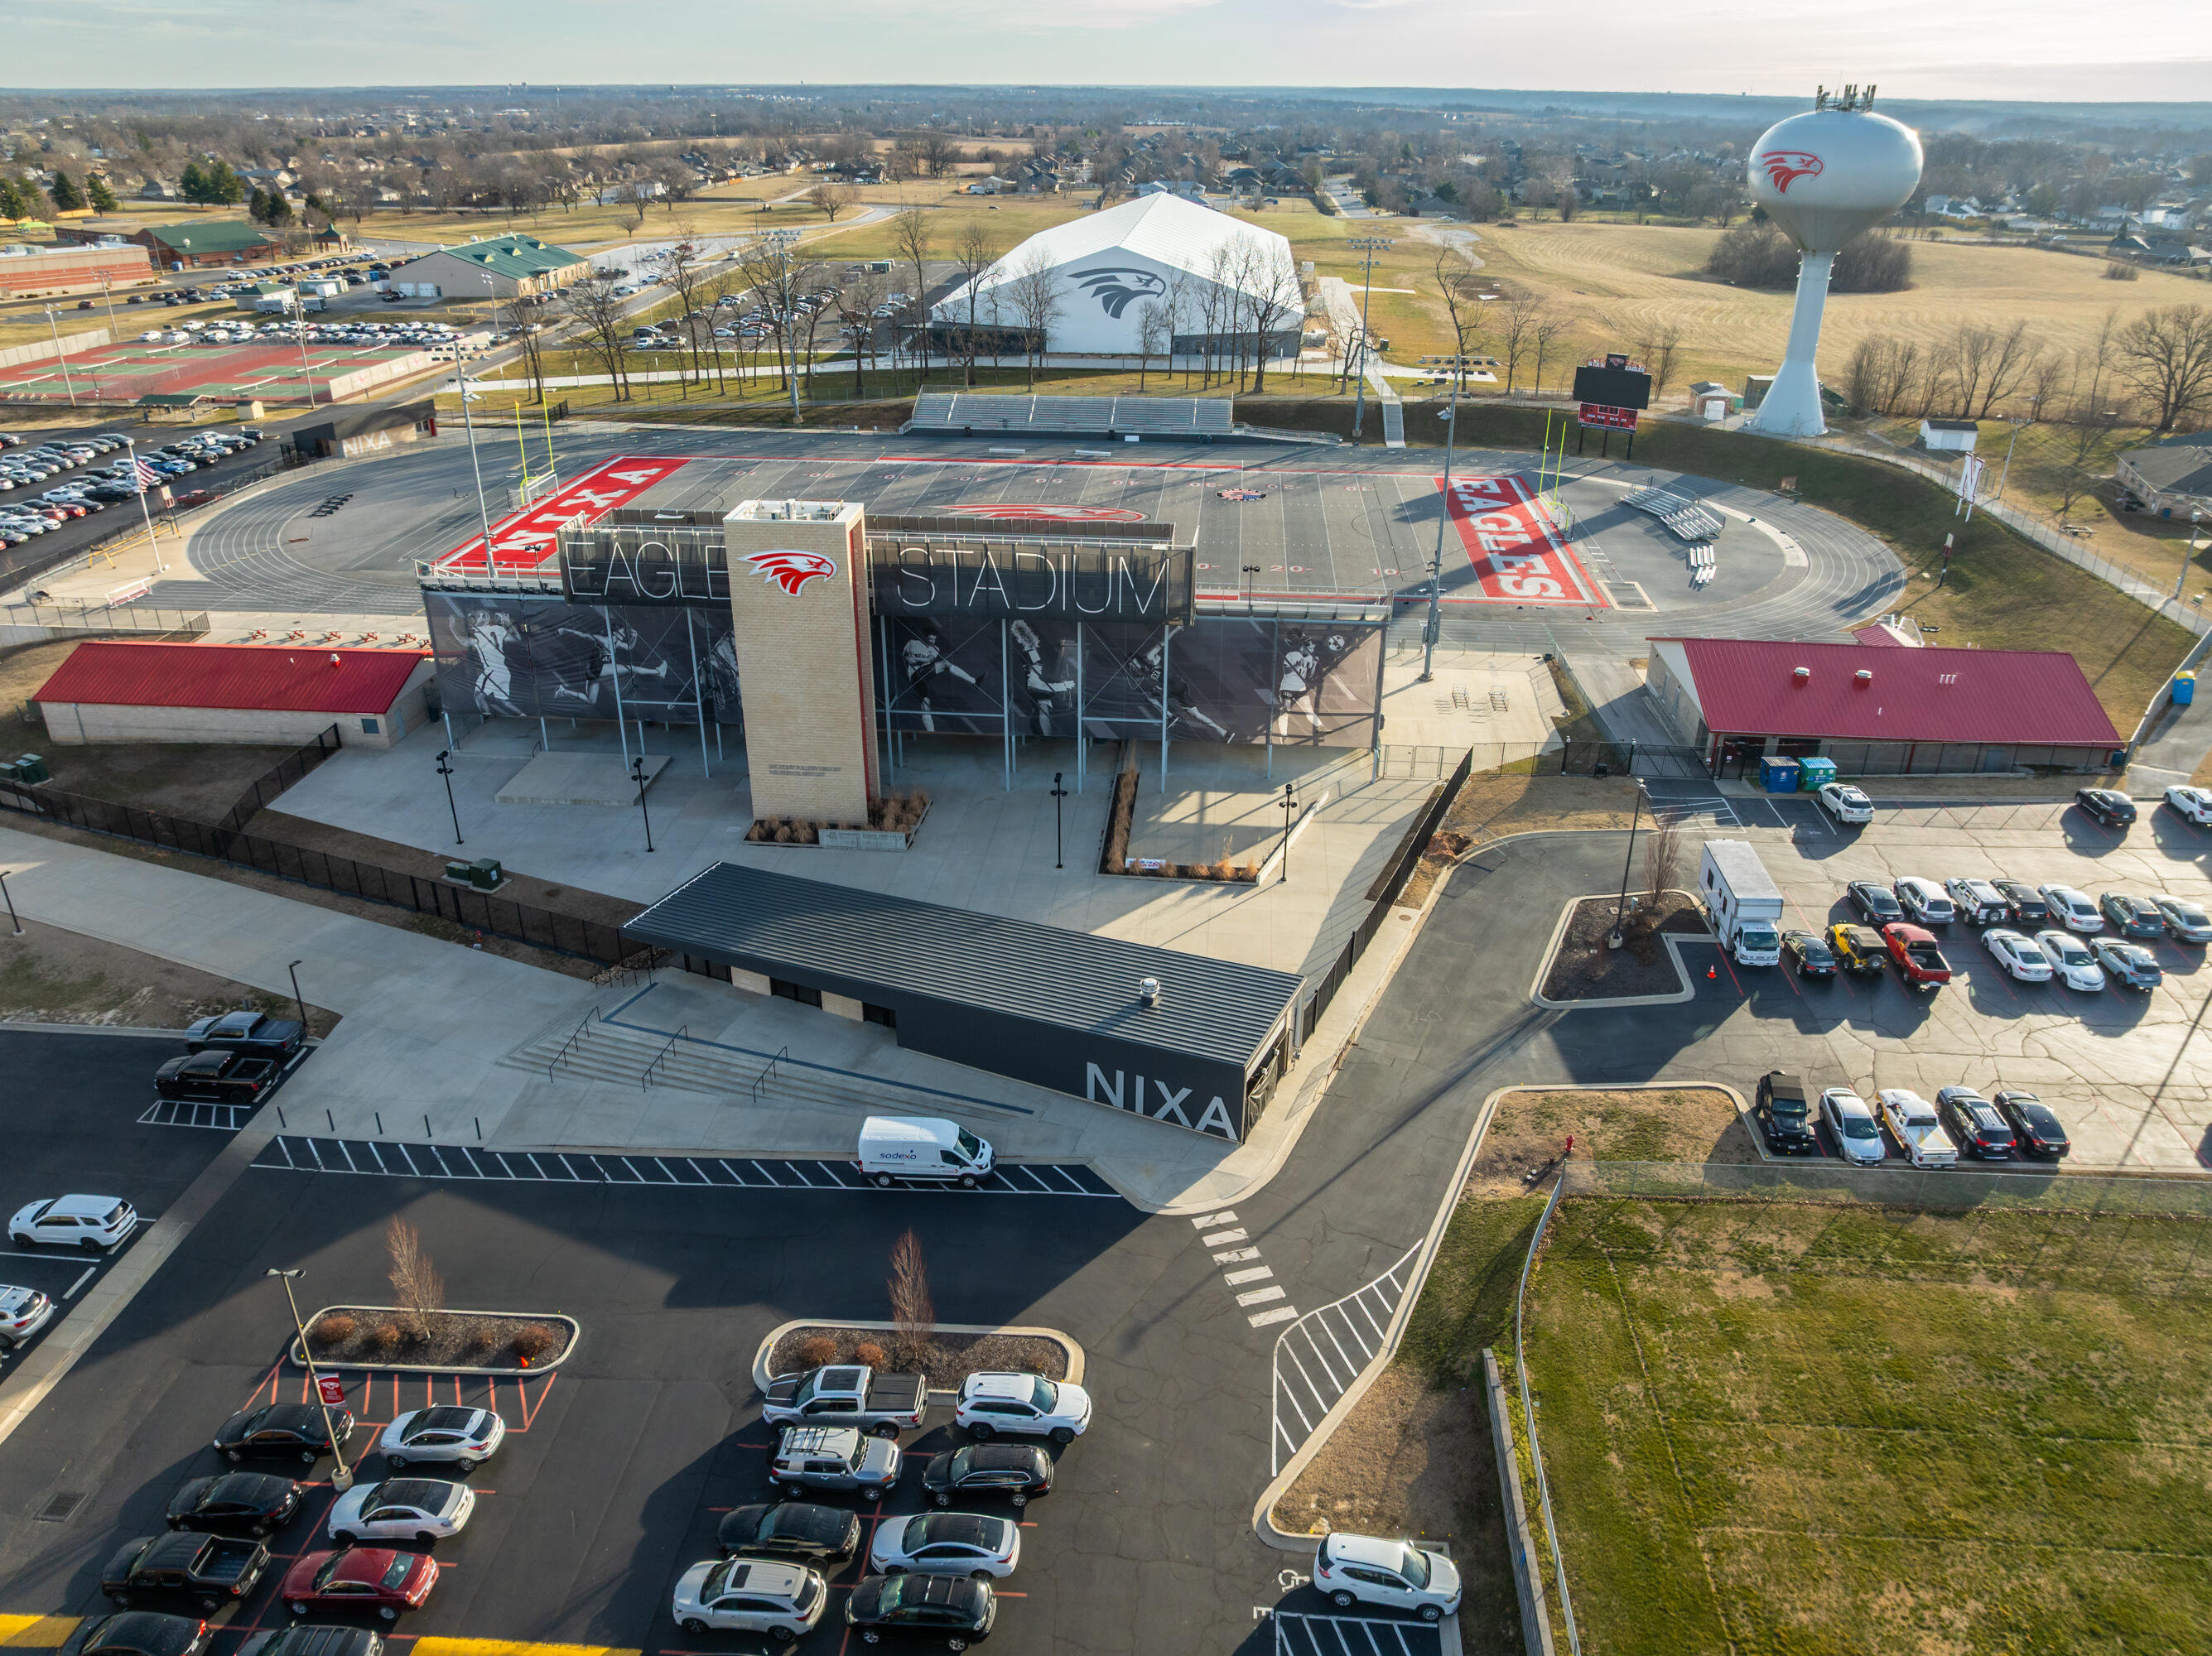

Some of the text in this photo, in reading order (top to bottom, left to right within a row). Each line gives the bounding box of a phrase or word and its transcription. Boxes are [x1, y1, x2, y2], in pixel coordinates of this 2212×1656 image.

[341, 431, 392, 458] NIXA
[490, 468, 664, 553] NIXA
[1450, 479, 1565, 597] EAGLES
[897, 547, 1170, 614] STADIUM
[1270, 565, 1305, 573] 20
[1087, 1061, 1238, 1141] NIXA
[879, 1151, 917, 1160] sodexo
